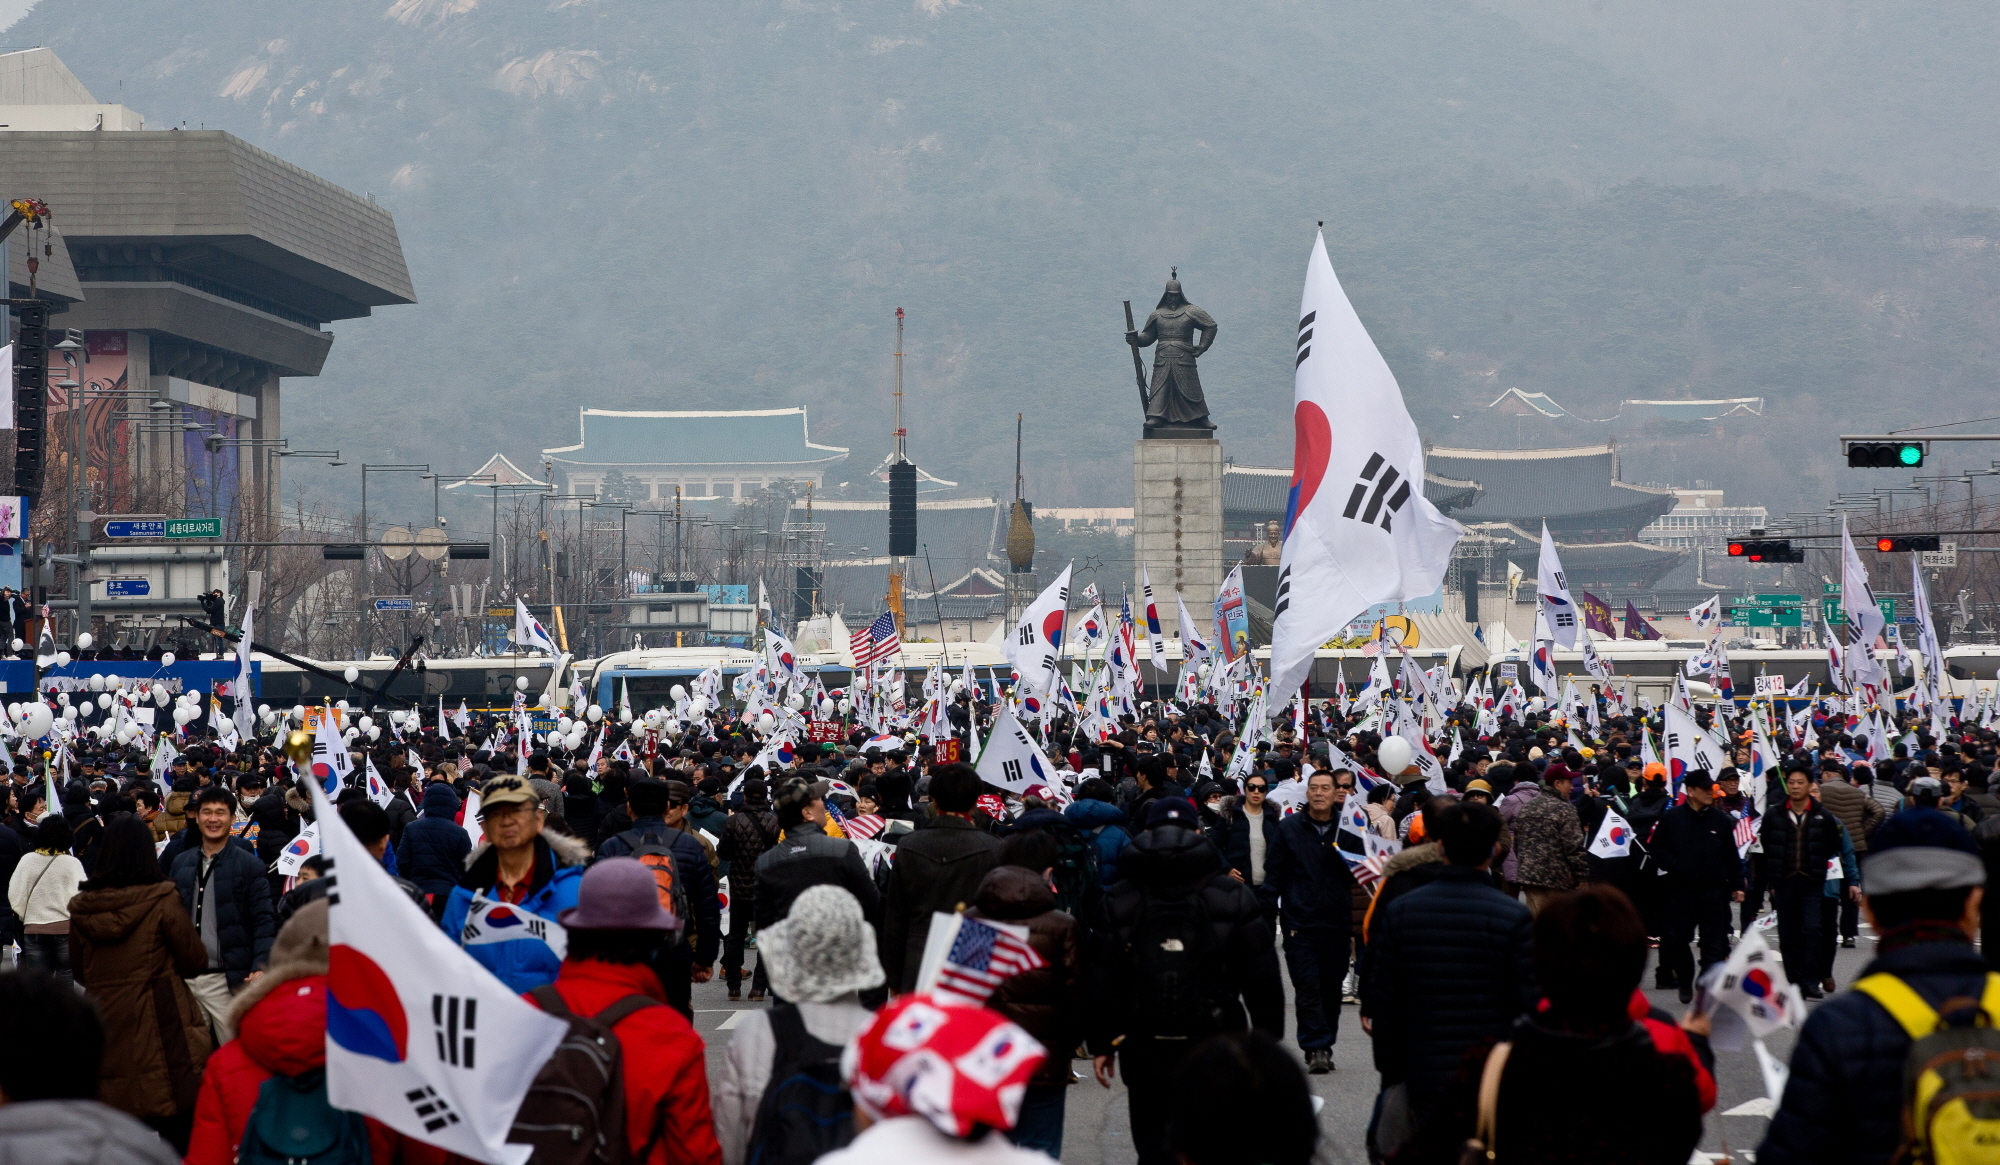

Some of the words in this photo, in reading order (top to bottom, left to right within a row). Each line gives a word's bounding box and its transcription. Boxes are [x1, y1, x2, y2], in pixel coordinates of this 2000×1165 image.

[132, 522, 163, 531] 새문안로
[169, 522, 215, 534] 세종대로사거리
[1923, 555, 1955, 565] 직좌신호
[108, 581, 123, 590] 종로
[1828, 584, 1842, 592] 광화
[1756, 677, 1772, 692] 강서
[1772, 676, 1783, 690] 12
[812, 722, 839, 732] 탄핵
[811, 731, 839, 741] 무효
[936, 743, 947, 763] 용산
[949, 741, 957, 761] 5
